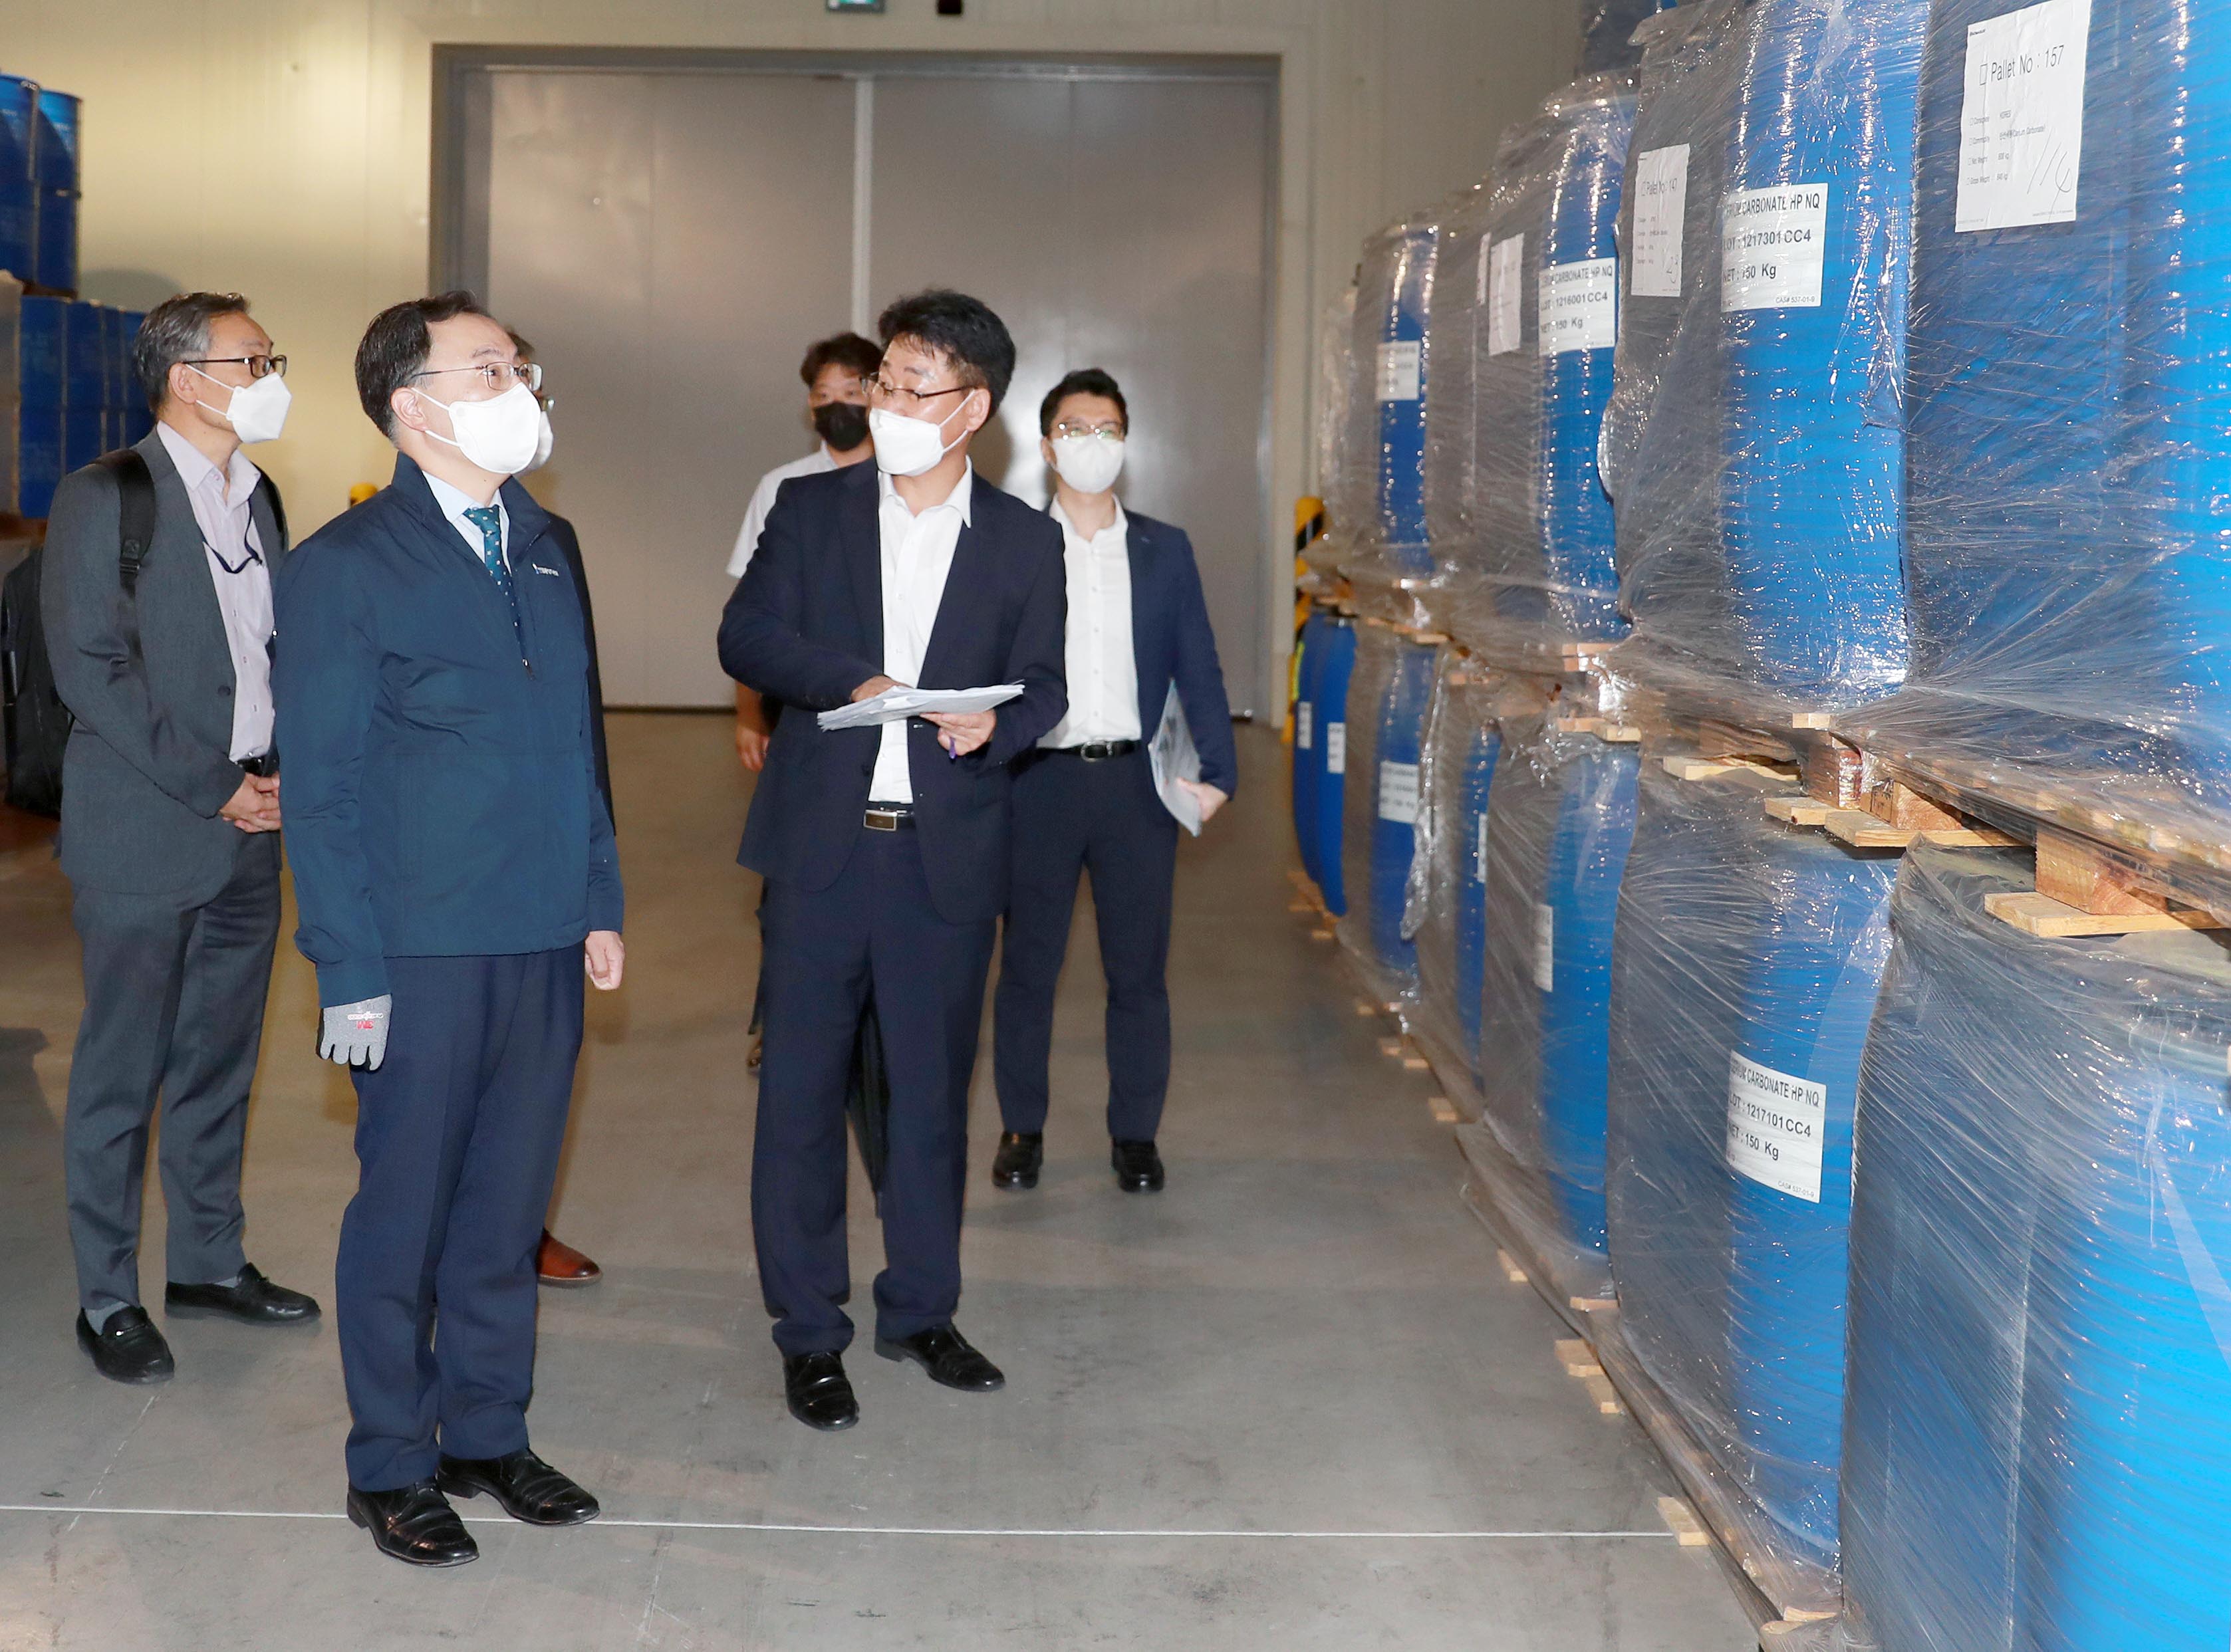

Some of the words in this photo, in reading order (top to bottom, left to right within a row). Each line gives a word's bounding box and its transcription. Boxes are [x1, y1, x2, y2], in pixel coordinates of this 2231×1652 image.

[1991, 59, 2016, 82] Pallet
[2020, 54, 2033, 75] No
[2045, 45, 2065, 68] 157
[1743, 196, 1787, 216] CARBONATE
[1790, 194, 1803, 210] HP
[1805, 193, 1820, 209] NQ
[1743, 229, 1811, 249] 1217301CC4
[1602, 264, 1613, 277] NQ
[1762, 263, 1776, 279] Kg
[1571, 317, 1583, 329] Kg
[1747, 1069, 1789, 1098] CARBONATE
[1791, 1086, 1803, 1102] HP
[1805, 1090, 1819, 1108] NQ
[1730, 1094, 1741, 1109] LOT
[1747, 1103, 1811, 1137] 1217101CC4
[1729, 1122, 1740, 1139] ET
[1746, 1133, 1760, 1150] 150
[1765, 1141, 1779, 1161] Kg
